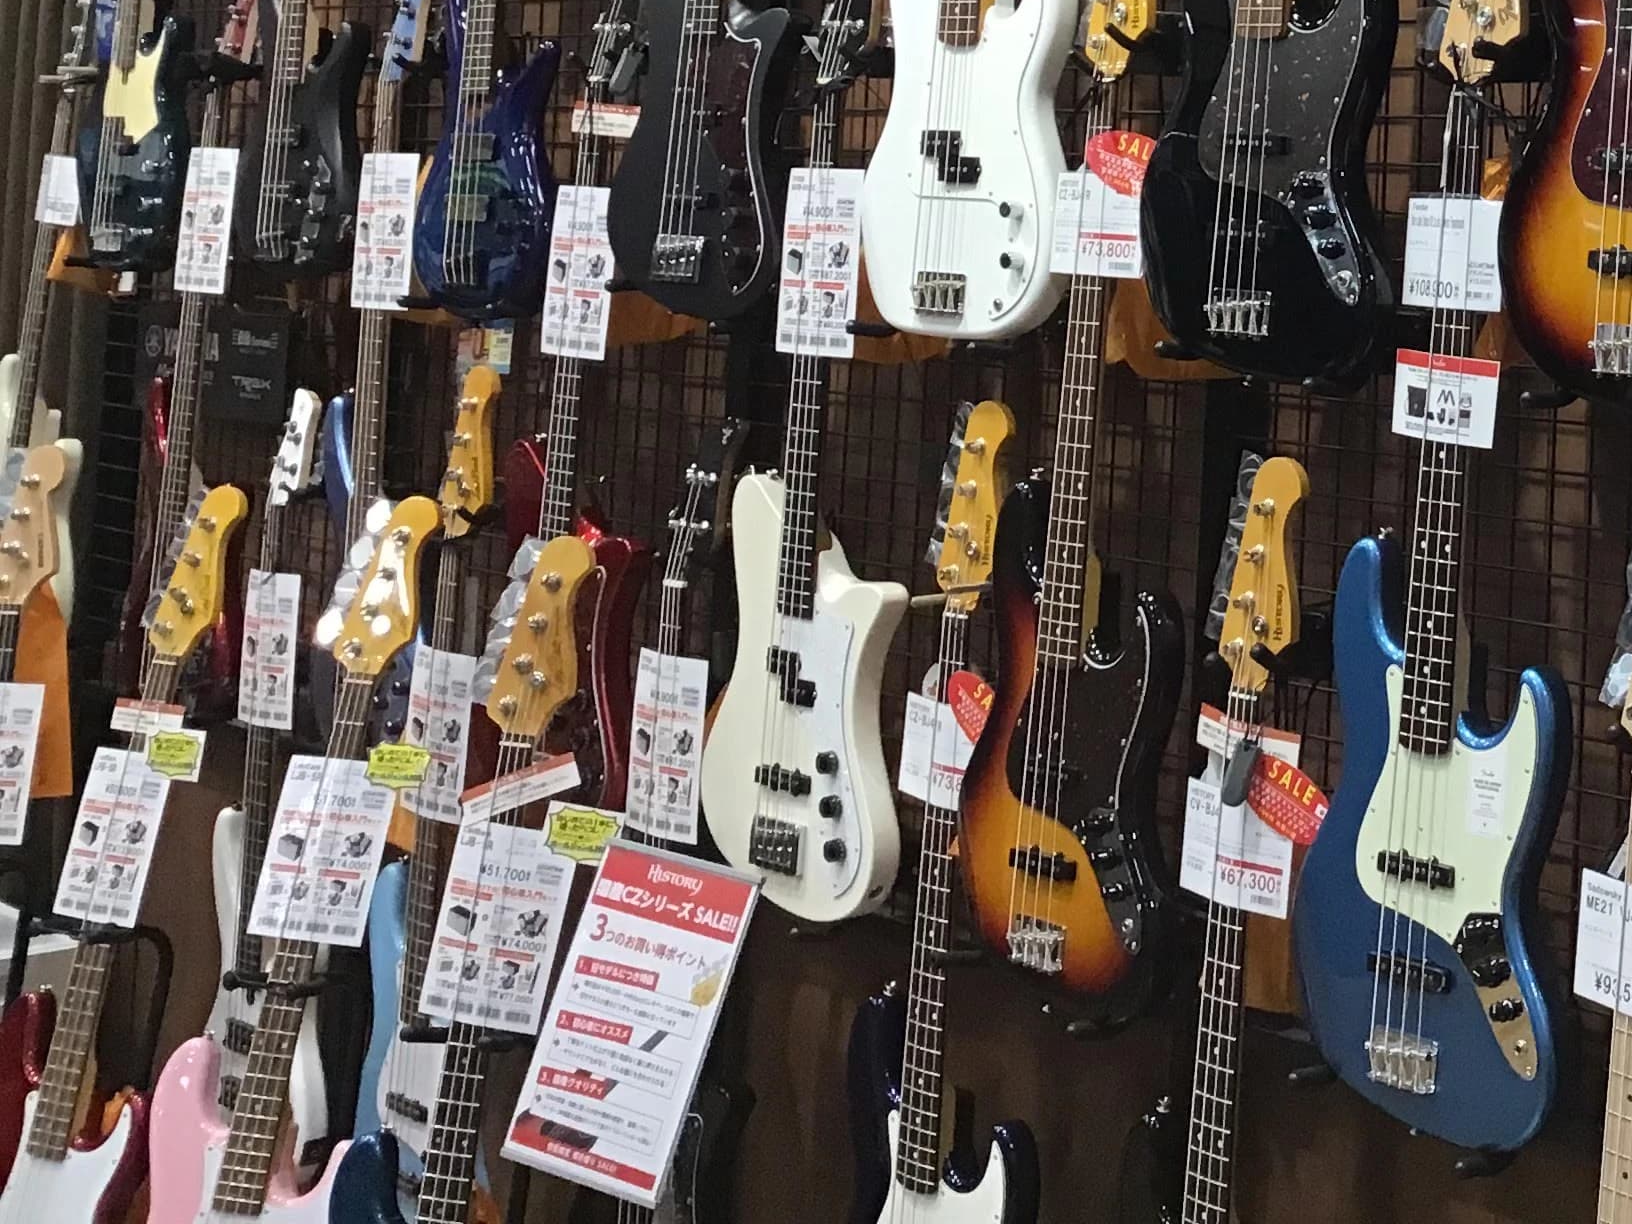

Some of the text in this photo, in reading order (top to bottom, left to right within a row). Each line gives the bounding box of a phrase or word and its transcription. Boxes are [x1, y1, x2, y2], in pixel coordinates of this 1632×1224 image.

[1268, 759, 1317, 806] SALE
[648, 864, 703, 897] HISTORY
[1220, 865, 1276, 893] ¥67,300
[1586, 895, 1613, 916] ME21
